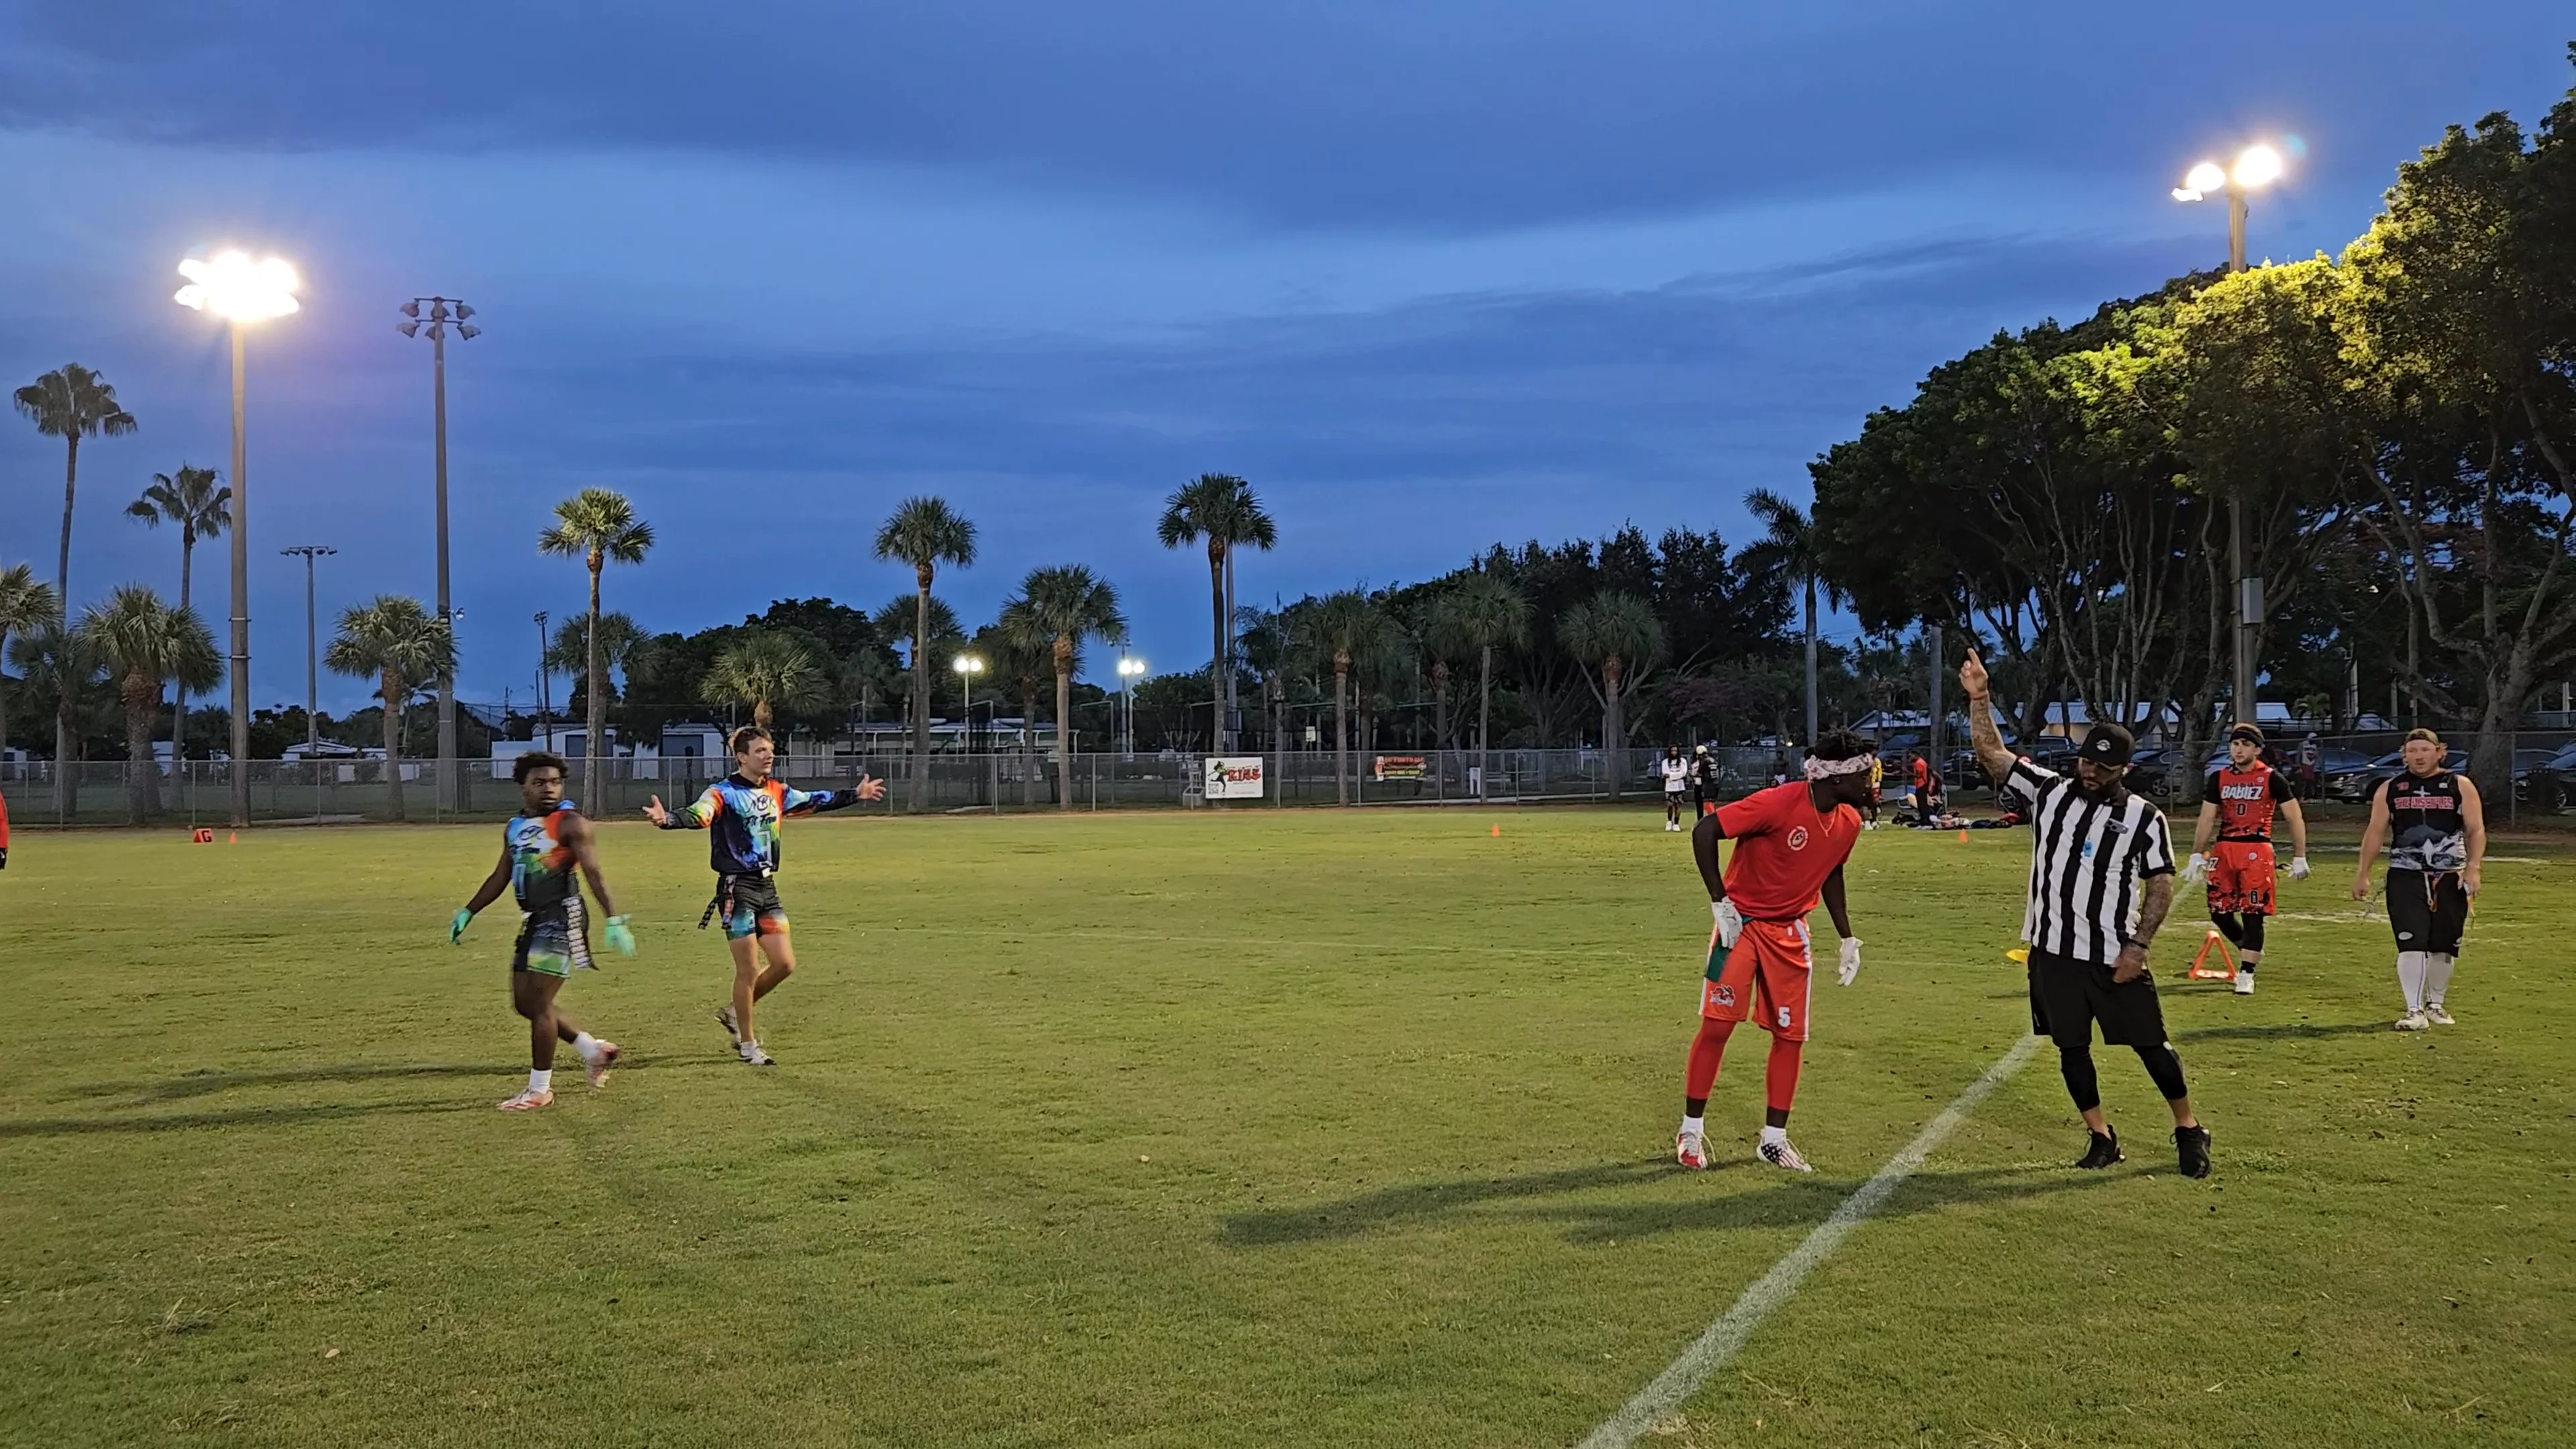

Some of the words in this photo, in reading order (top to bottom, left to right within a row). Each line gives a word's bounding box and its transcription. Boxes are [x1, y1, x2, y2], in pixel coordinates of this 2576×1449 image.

[2235, 803, 2247, 816] 0
[201, 830, 212, 843] G
[1778, 1006, 1791, 1028] 5
